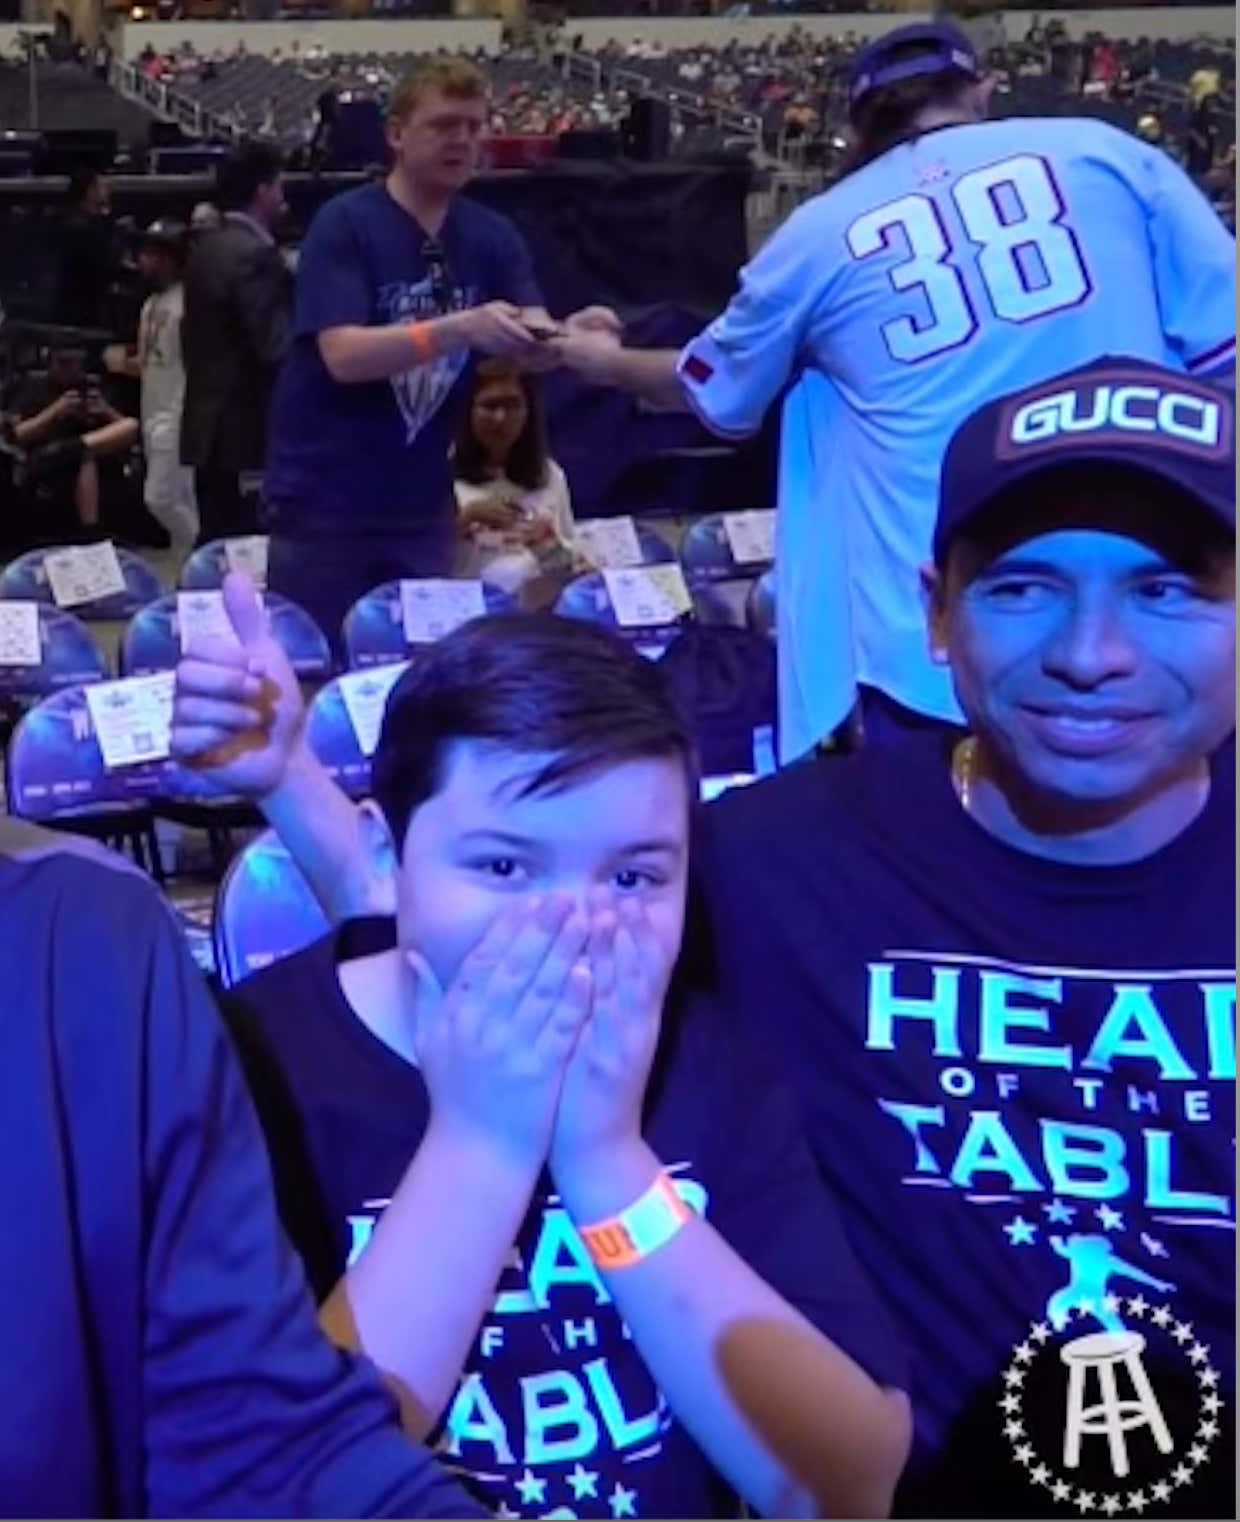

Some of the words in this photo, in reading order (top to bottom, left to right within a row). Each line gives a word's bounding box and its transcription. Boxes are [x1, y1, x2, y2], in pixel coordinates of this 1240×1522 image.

[847, 153, 1093, 364] 38
[1012, 386, 1218, 445] GUCCI
[940, 1066, 1019, 1098] OF
[1073, 1077, 1211, 1121] THE
[877, 1098, 1236, 1214] TABL
[447, 1358, 672, 1464] ABL
